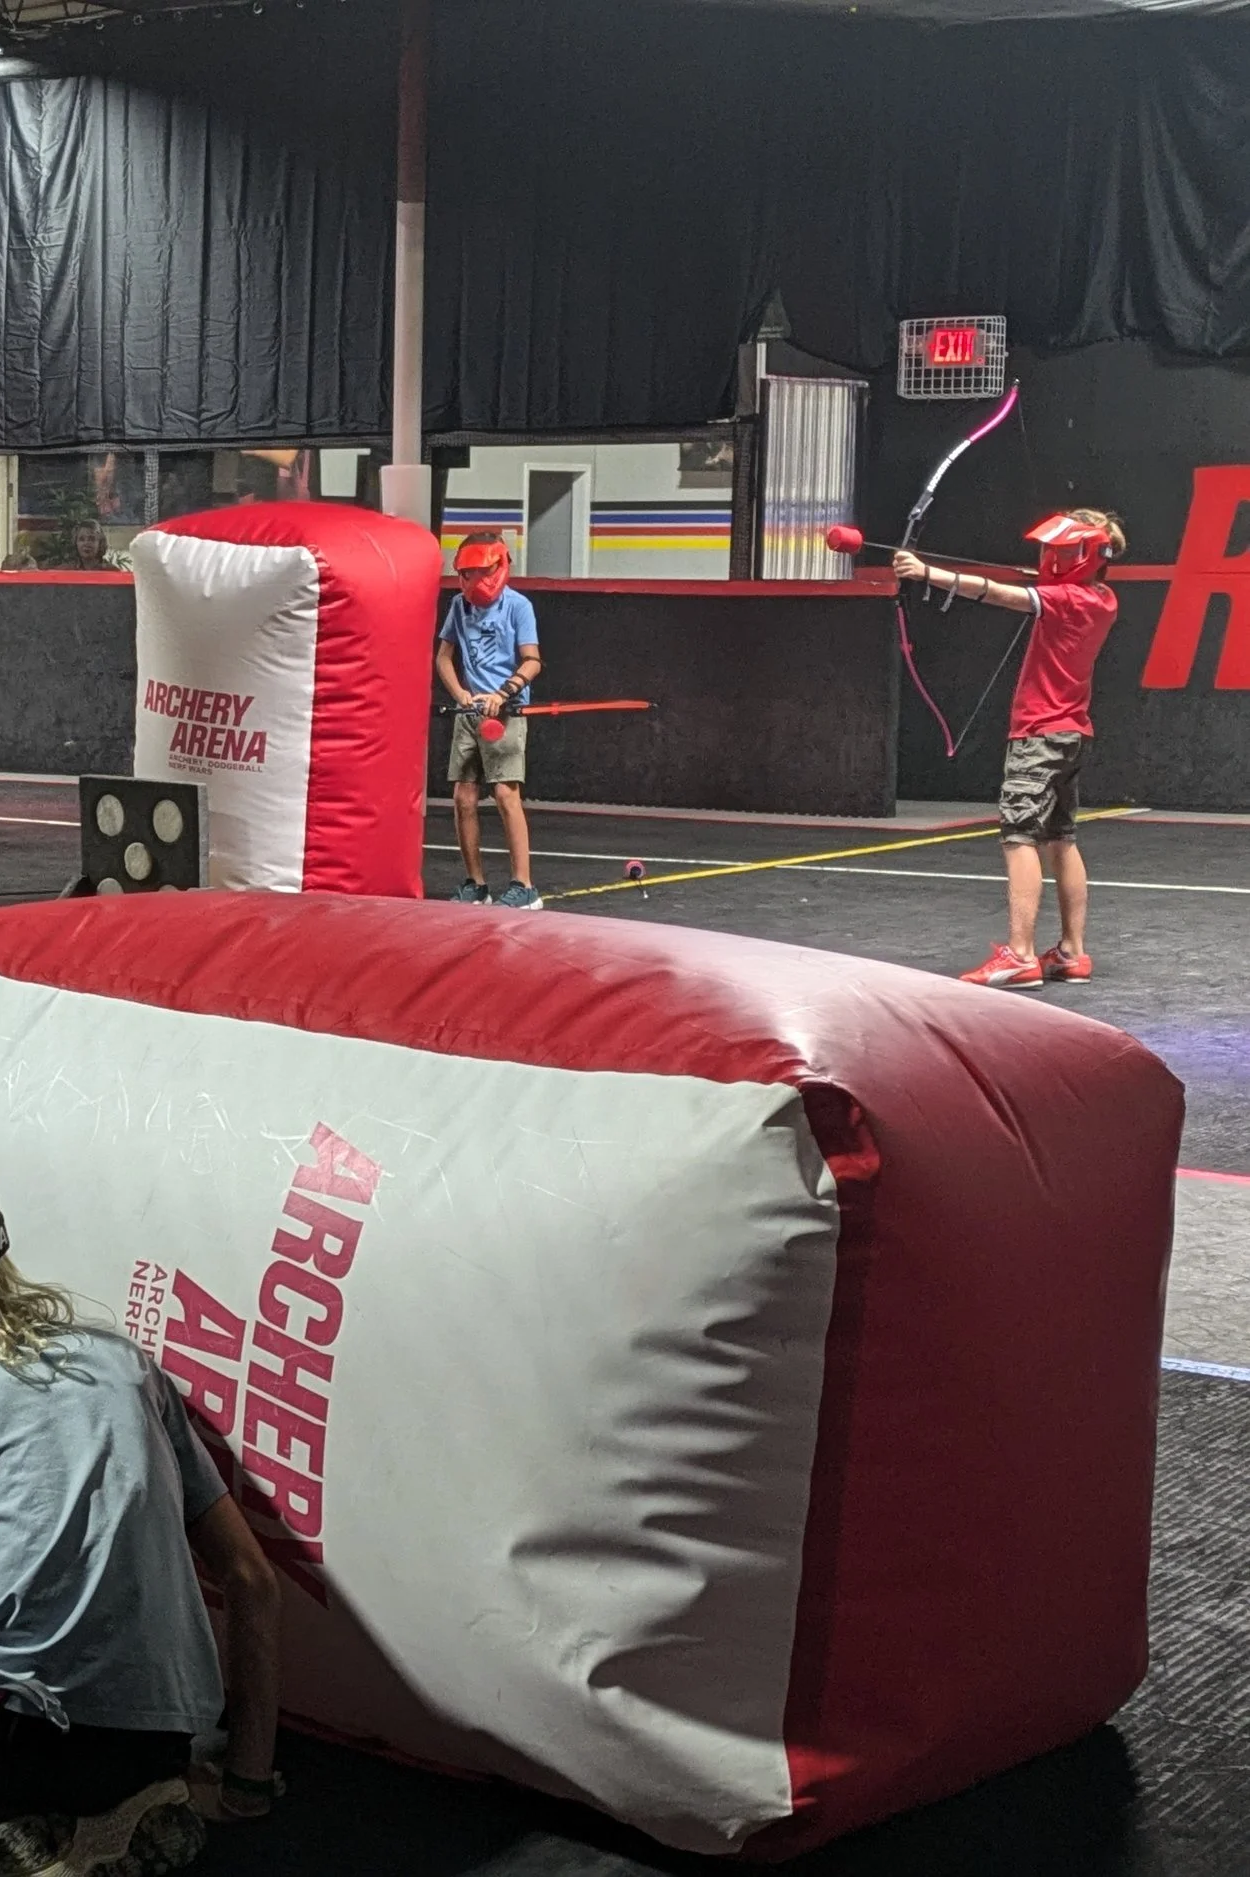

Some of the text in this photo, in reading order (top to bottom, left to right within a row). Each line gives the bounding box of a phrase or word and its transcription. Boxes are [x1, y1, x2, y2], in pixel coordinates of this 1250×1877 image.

[934, 331, 976, 362] EXIT
[144, 679, 255, 728] ARCHERY
[170, 722, 267, 764] ARENA
[188, 765, 213, 776] WARS
[207, 760, 263, 773] DODGEBALL
[122, 1260, 150, 1342] NERF
[241, 1120, 384, 1610] ARCHERY
